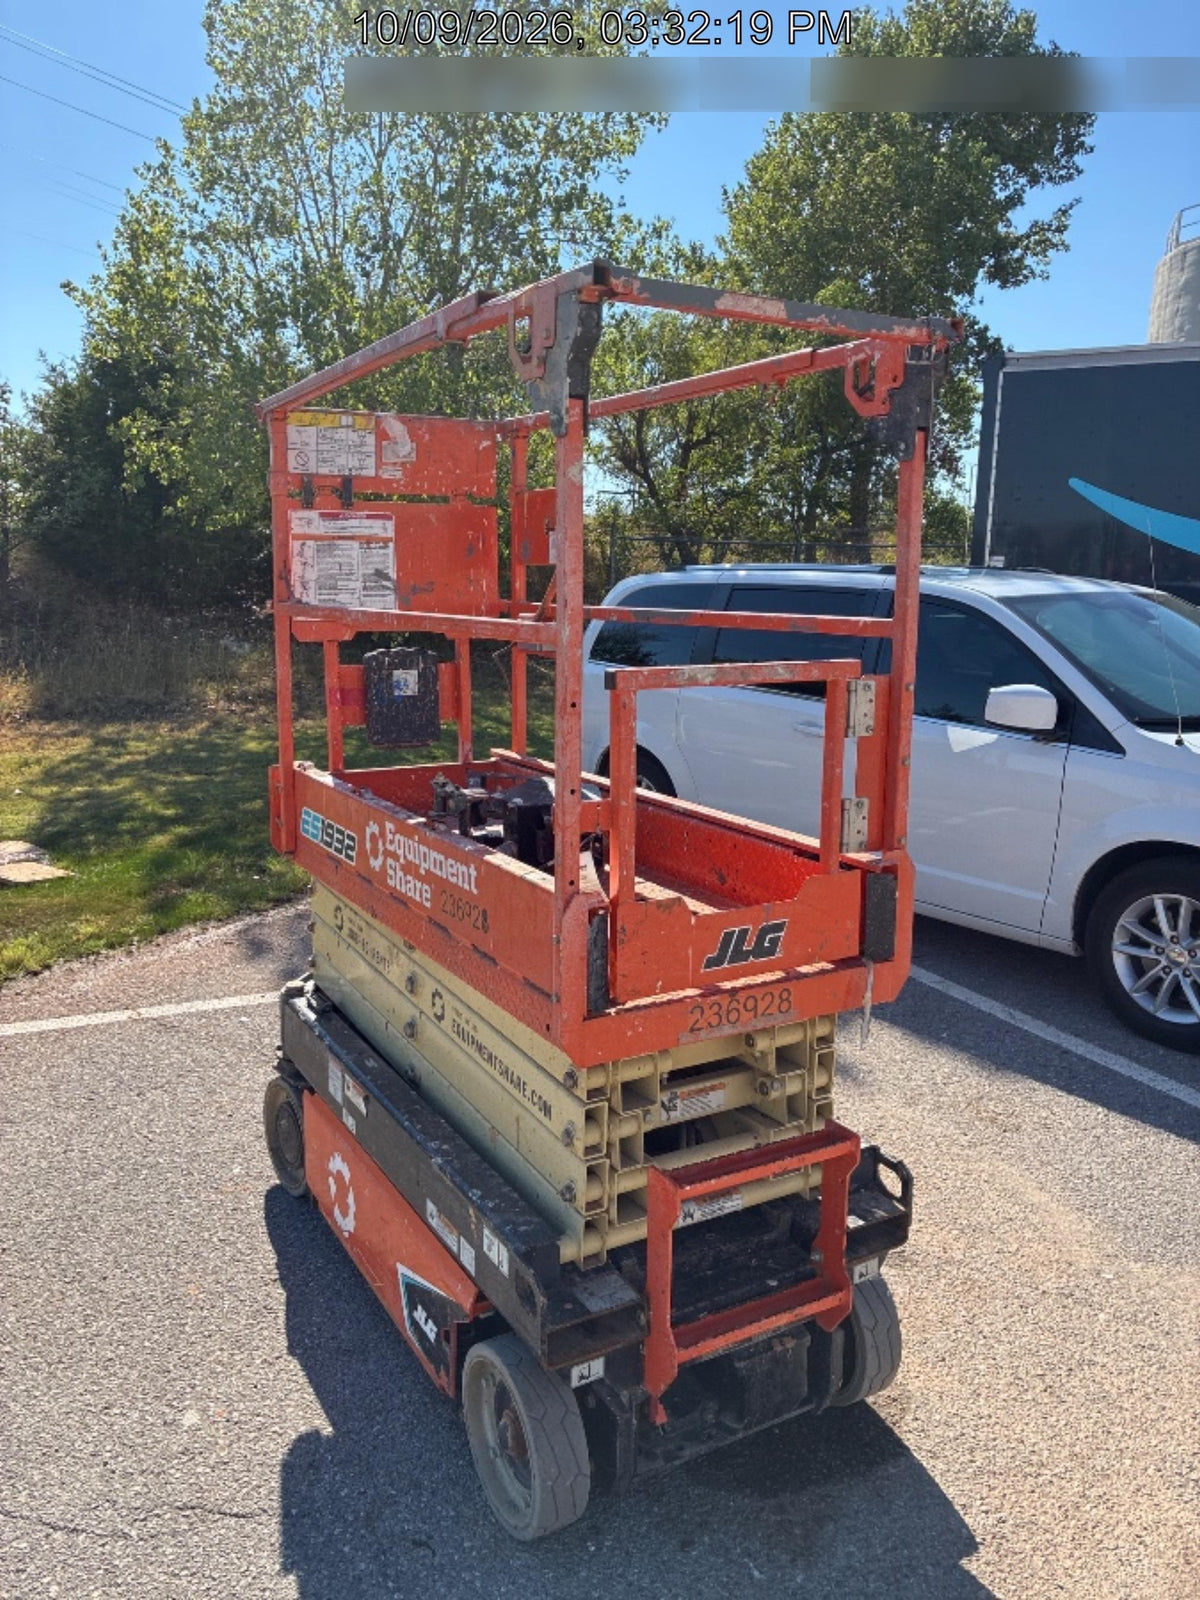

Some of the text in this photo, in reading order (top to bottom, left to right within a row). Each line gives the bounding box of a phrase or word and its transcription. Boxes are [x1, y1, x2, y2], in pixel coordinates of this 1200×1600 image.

[385, 821, 478, 895] Equipment
[702, 920, 788, 971] JLG
[689, 988, 792, 1032] 236928
